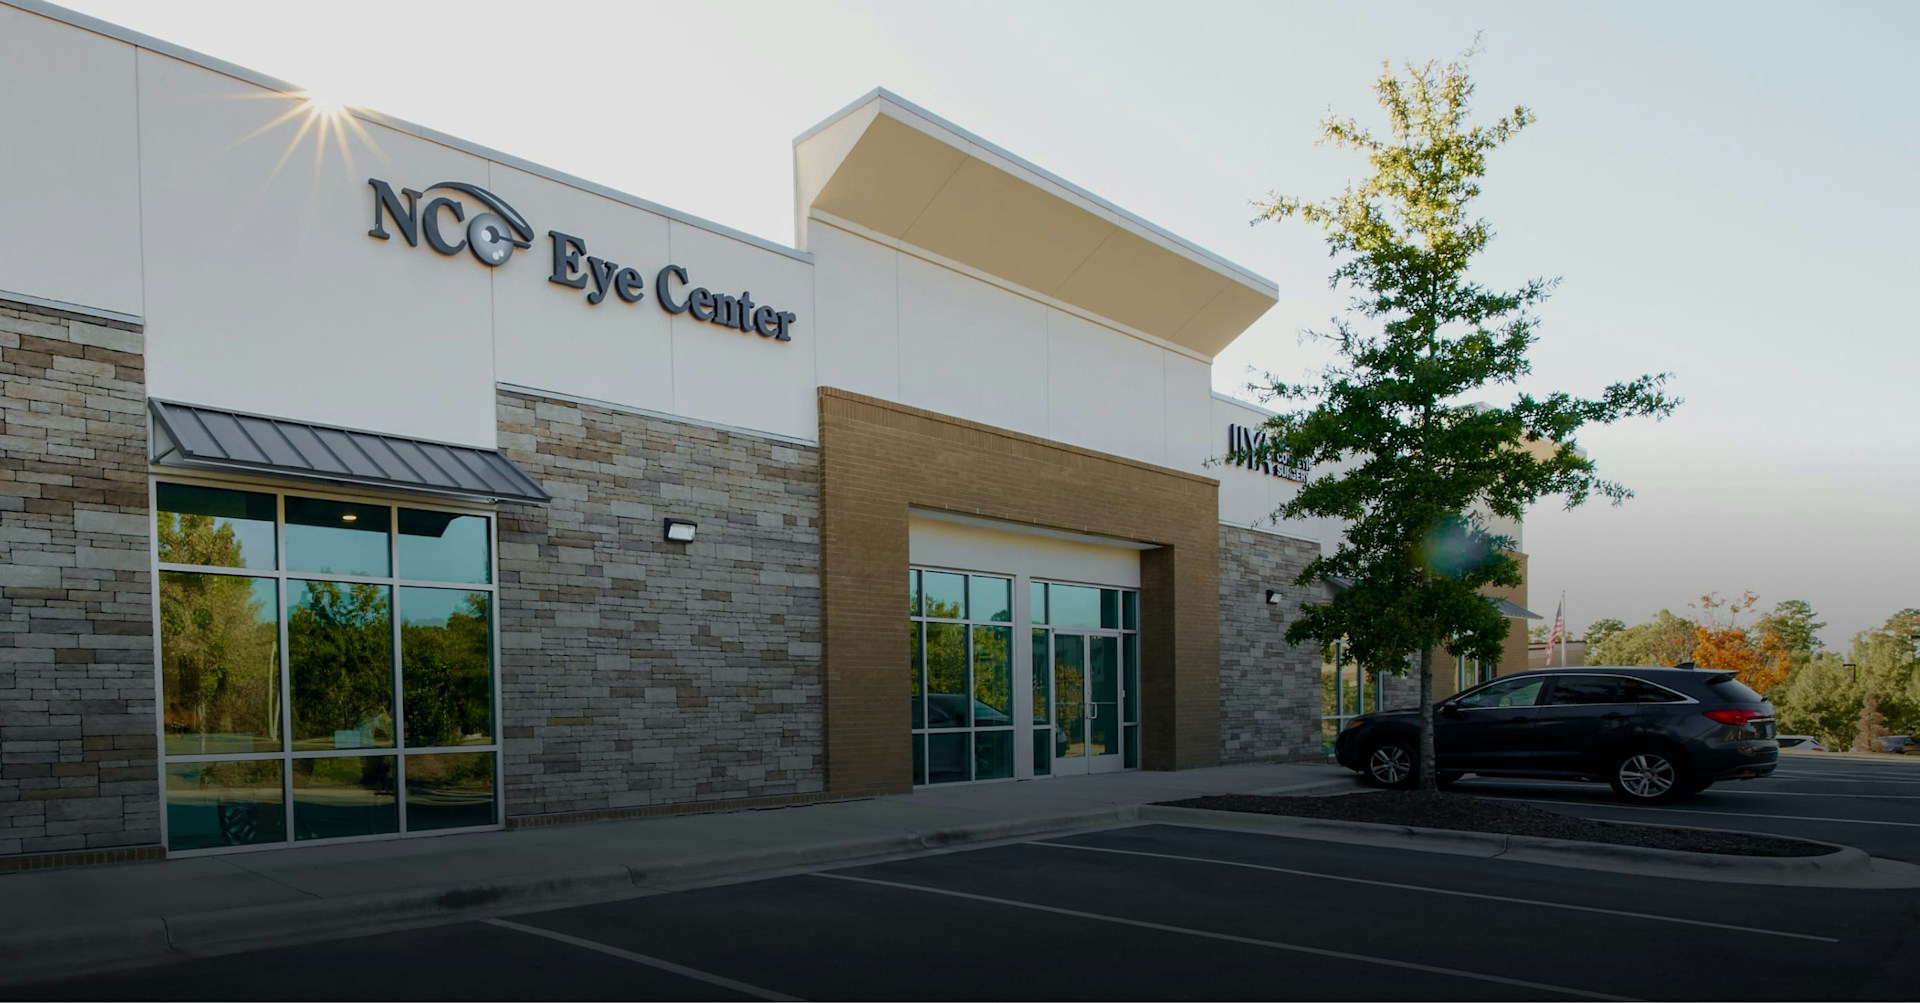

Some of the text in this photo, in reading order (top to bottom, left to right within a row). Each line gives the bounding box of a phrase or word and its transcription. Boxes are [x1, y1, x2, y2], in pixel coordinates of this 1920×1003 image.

[548, 230, 644, 304] Eye
[655, 264, 797, 342] Center
[1276, 464, 1310, 484] SURGERY
